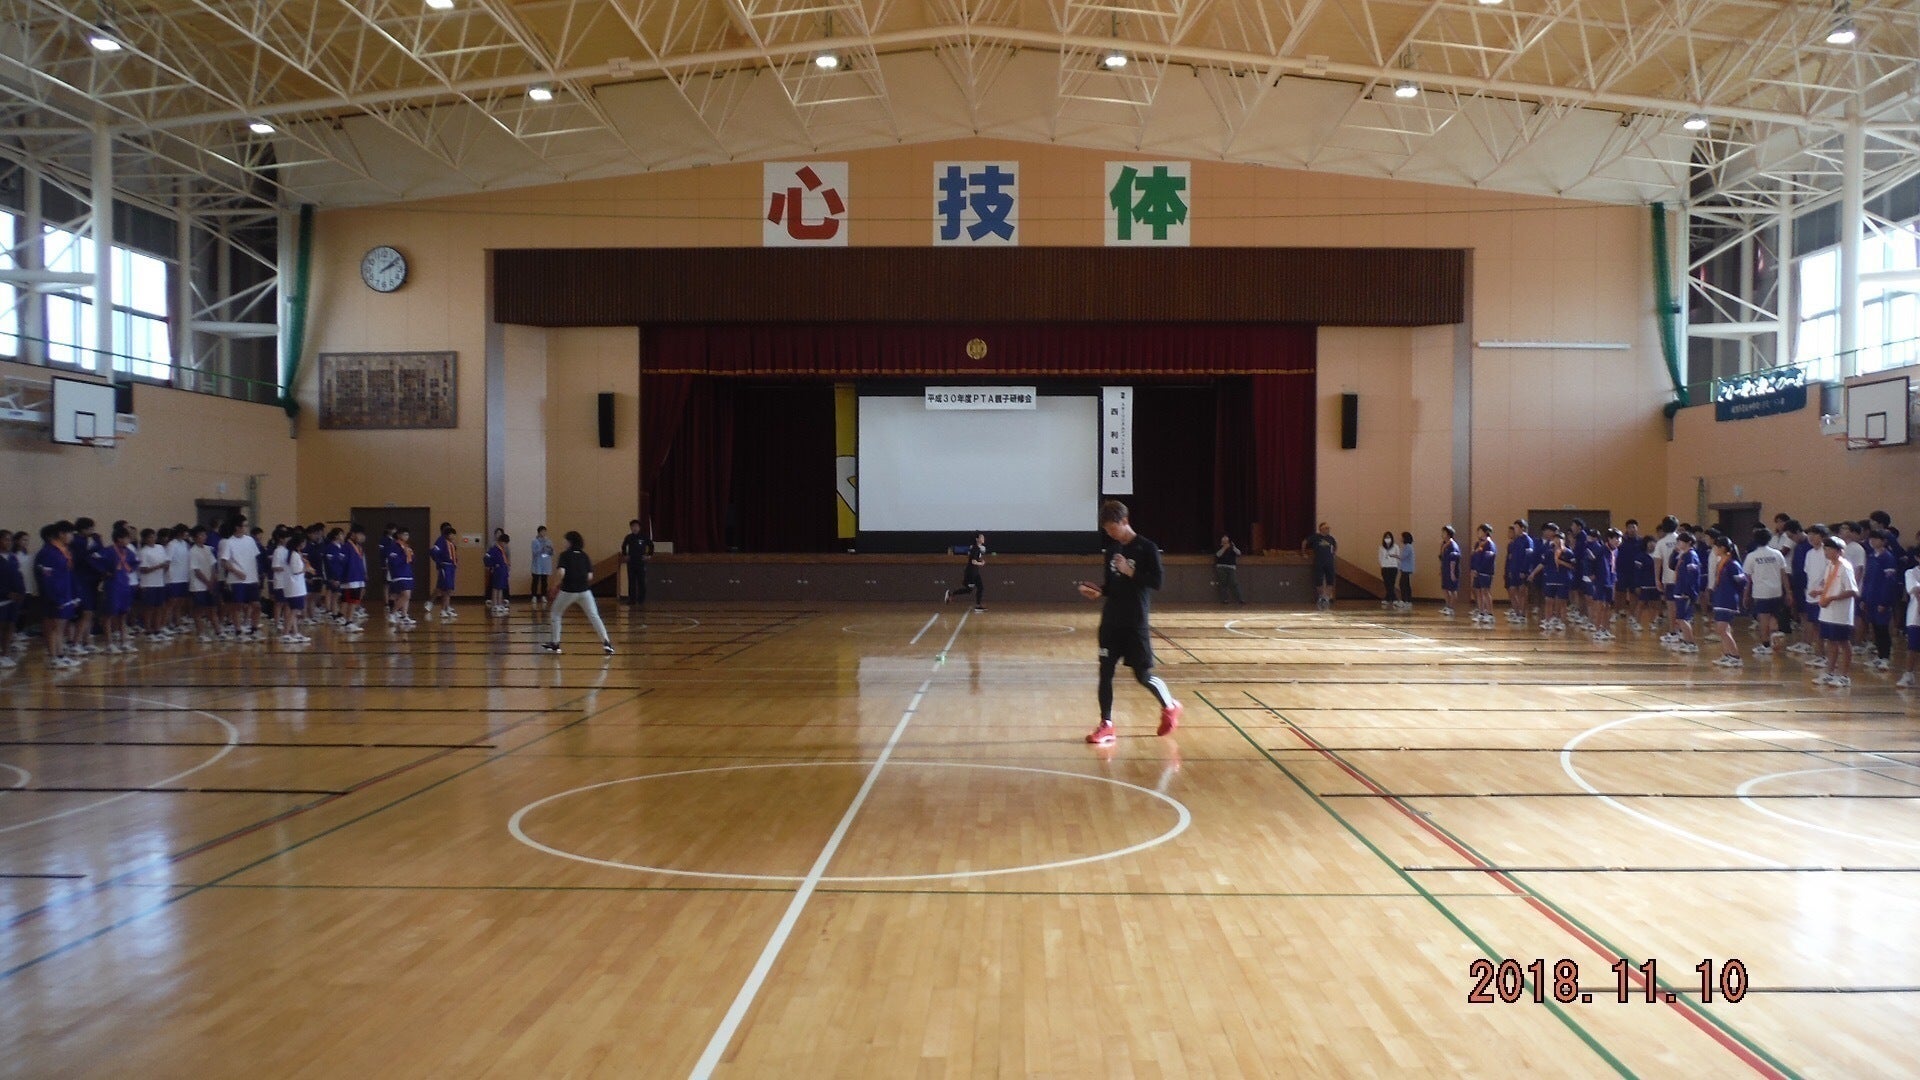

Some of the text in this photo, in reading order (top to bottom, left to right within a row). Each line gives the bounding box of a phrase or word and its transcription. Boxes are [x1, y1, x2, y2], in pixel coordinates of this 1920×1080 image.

[767, 165, 1187, 242] 心 技 体
